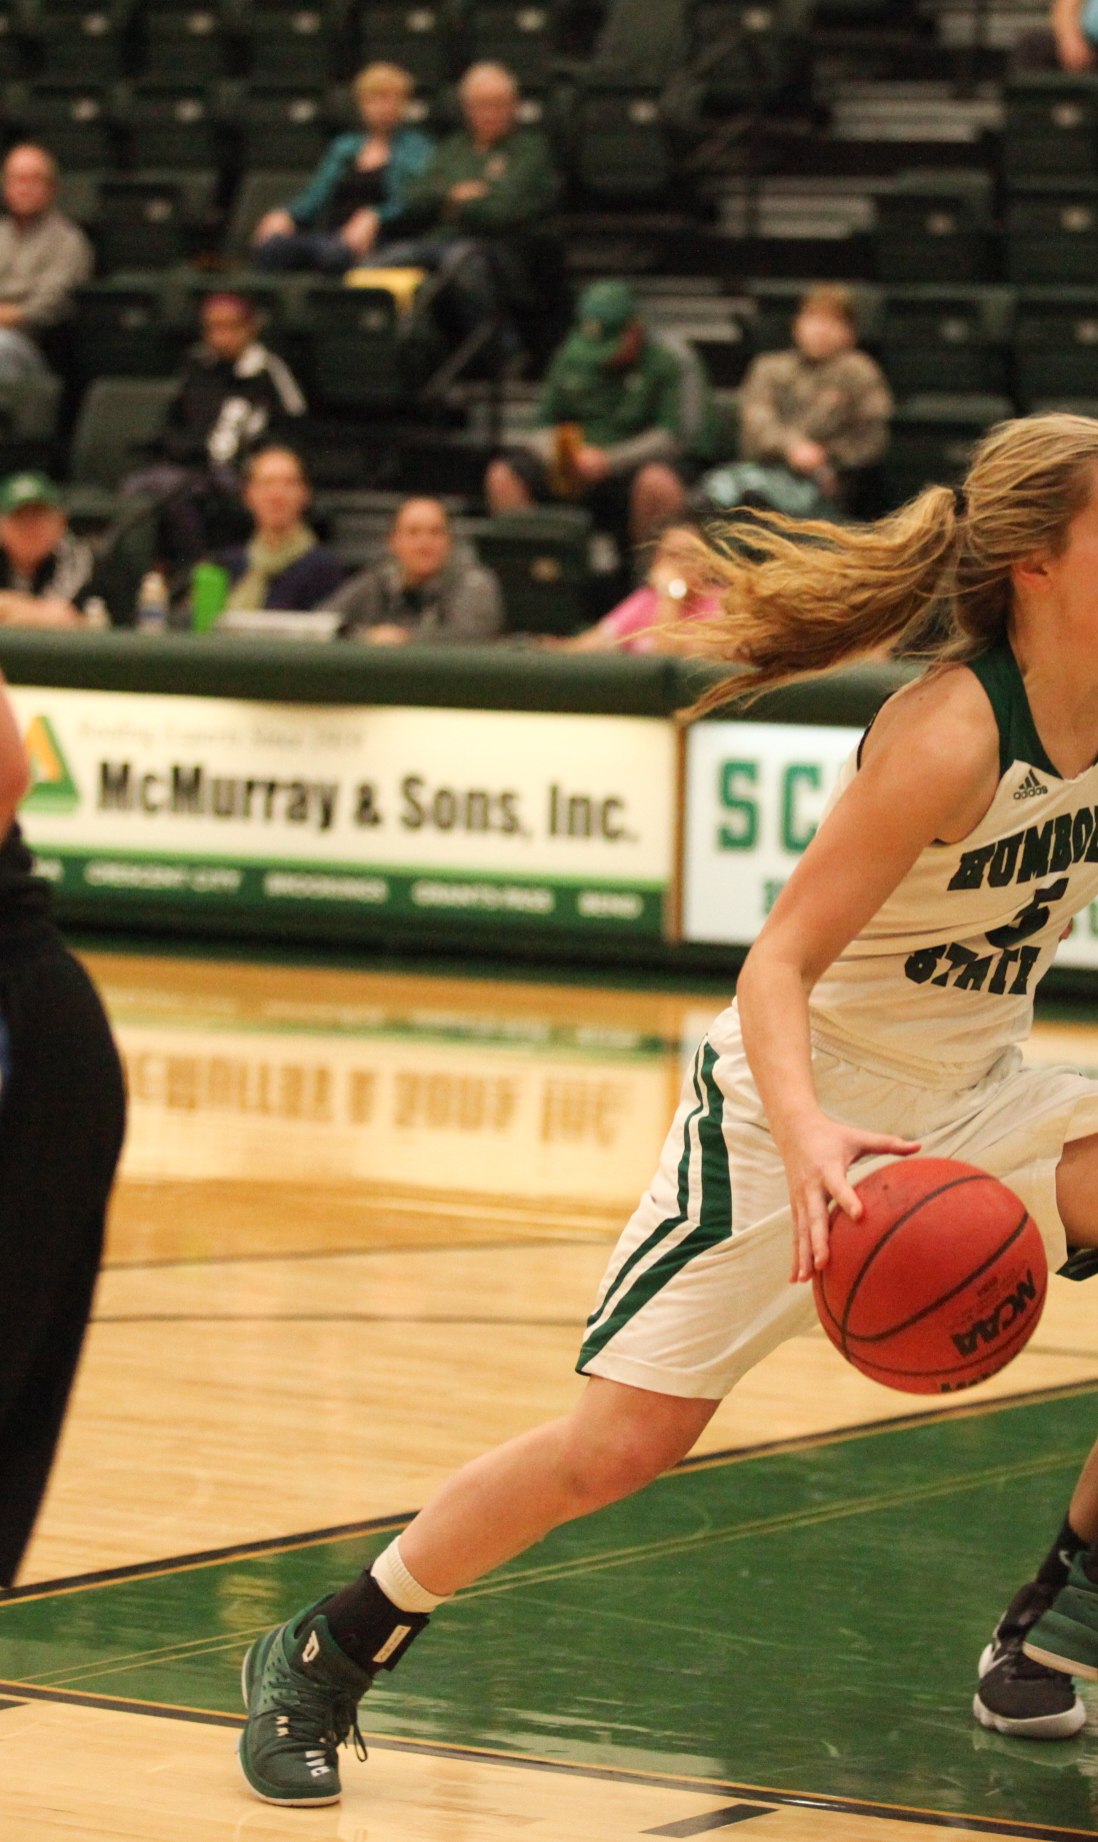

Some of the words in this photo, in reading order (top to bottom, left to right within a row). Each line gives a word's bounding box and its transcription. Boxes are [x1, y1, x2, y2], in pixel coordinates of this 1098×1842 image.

[98, 760, 340, 832] McMurray
[356, 783, 383, 827] &
[548, 784, 641, 842] Inc.
[1013, 785, 1049, 801] adidas
[985, 878, 1070, 950] 5
[951, 1267, 1036, 1357] NCAA
